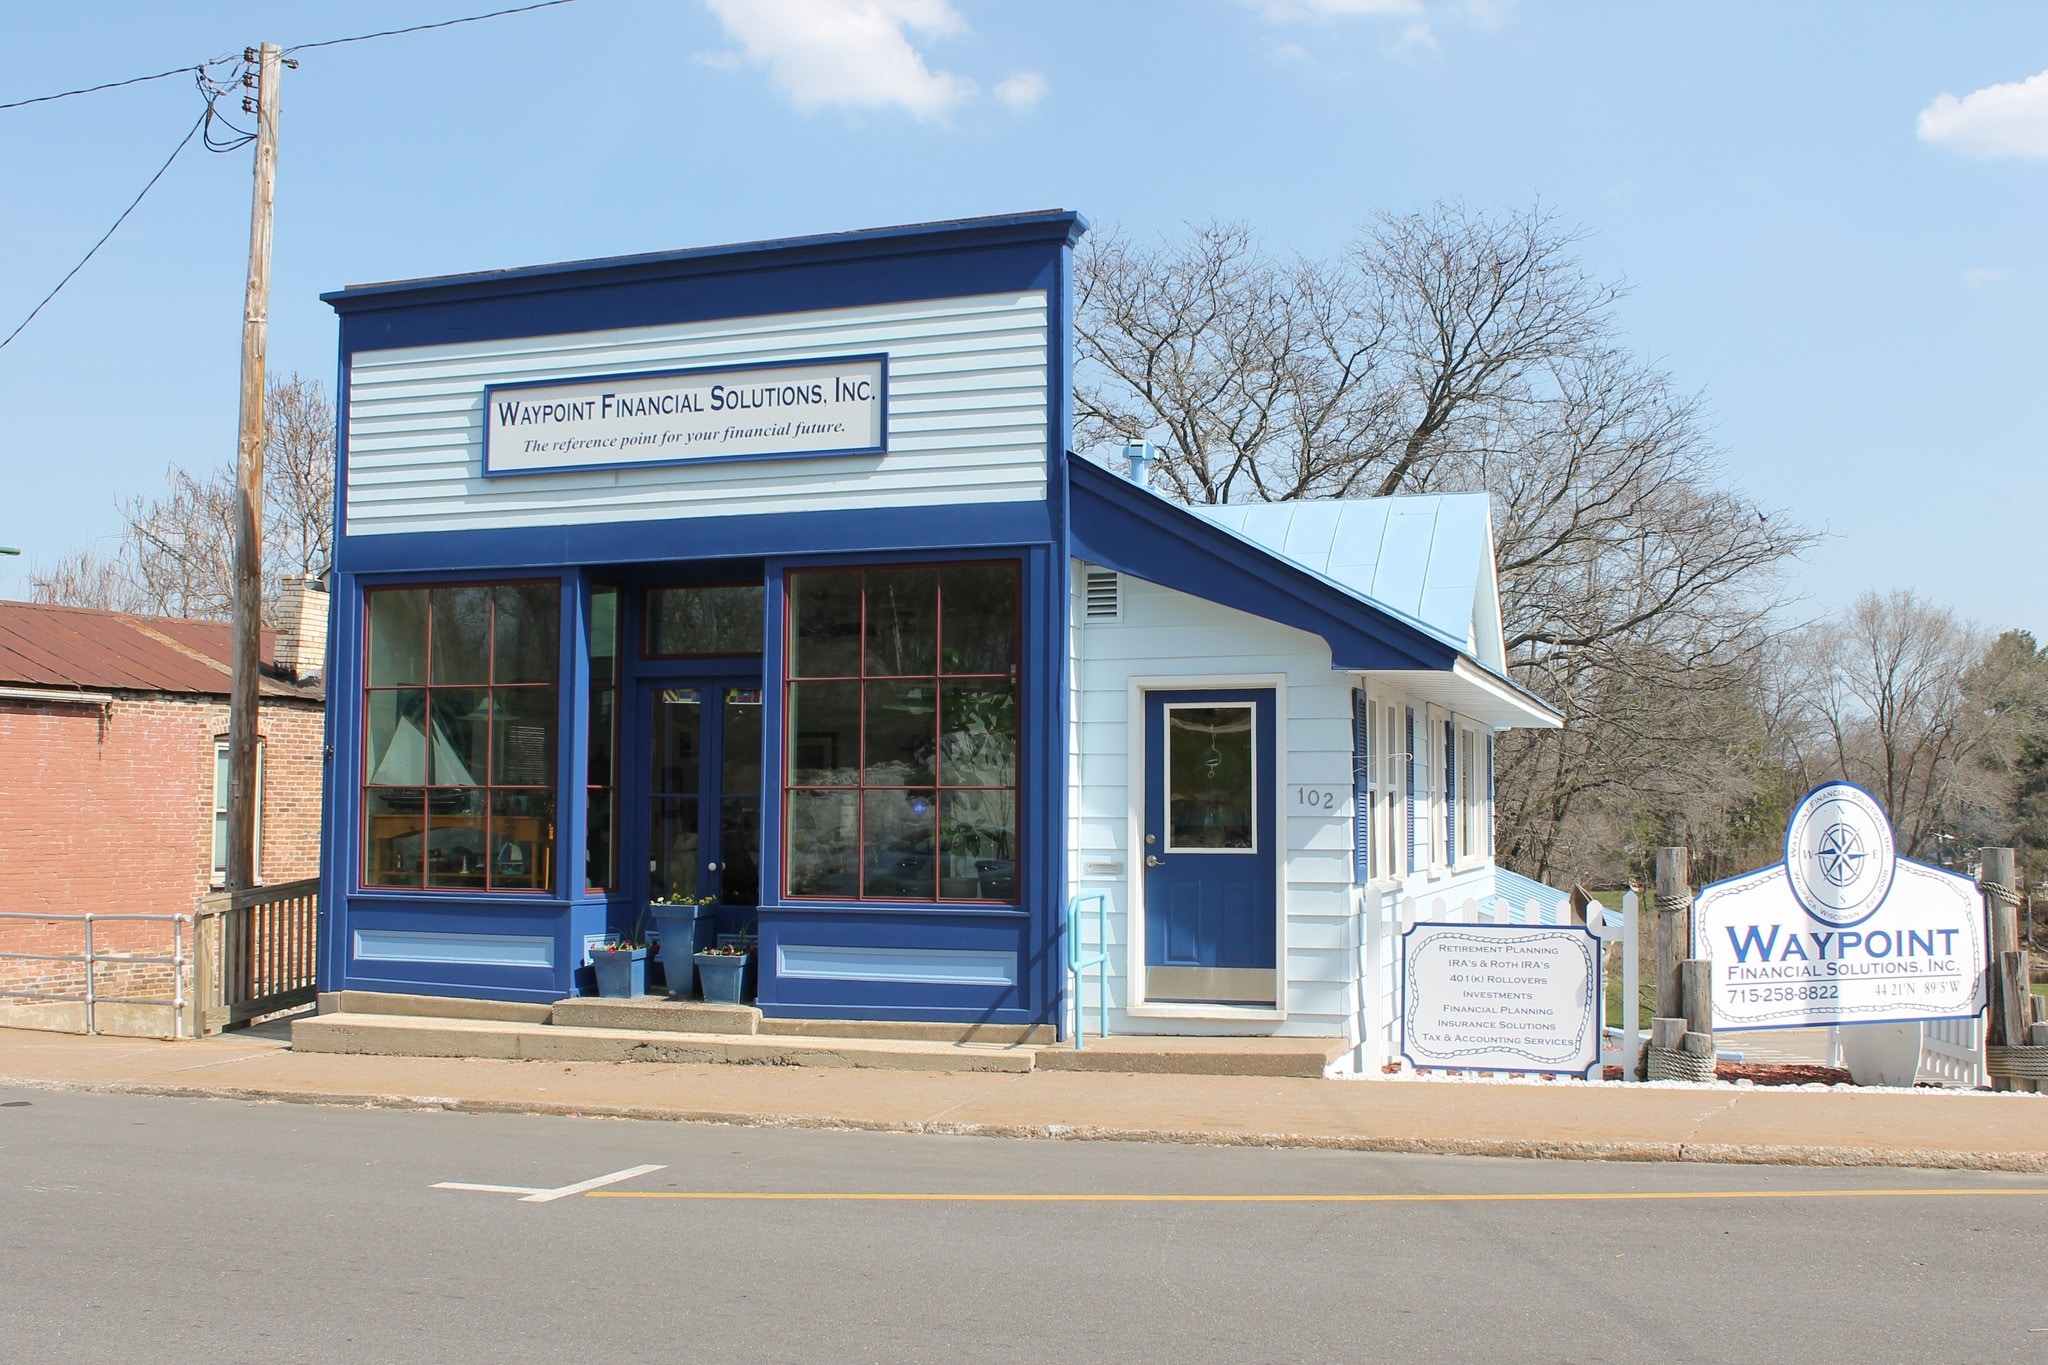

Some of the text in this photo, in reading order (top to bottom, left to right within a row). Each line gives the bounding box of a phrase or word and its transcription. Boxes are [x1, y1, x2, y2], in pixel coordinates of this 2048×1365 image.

[498, 376, 876, 426] WAYPOINT FINANCIAL SOLUTIONS, INC.
[523, 419, 845, 454] The reference point for your financial future.
[1298, 786, 1333, 809] 102
[1836, 805, 1845, 815] N
[1791, 809, 1811, 858] WAYPOINT
[1809, 789, 1853, 808] FINANCIAL
[1803, 849, 1814, 860] W
[1872, 849, 1880, 860] E
[1820, 907, 1860, 921] WISCONSIN
[1877, 869, 1889, 893] 2008
[1839, 895, 1846, 905] S
[1439, 944, 1559, 955] RETIREMENT PLANNING
[1724, 924, 1959, 964] WAYPOINT
[1480, 960, 1488, 968] &
[1490, 960, 1519, 969] ROTH
[1728, 958, 1959, 980] FINANCIAL SOLUTIONS, INC.
[1487, 975, 1548, 985] ROLLOVERS
[1462, 990, 1533, 1000] INVESTMENTS
[1727, 985, 1839, 1004] 715-258-8822
[1443, 1004, 1554, 1016] FINANCIAL PLANNING
[1437, 1019, 1556, 1031] INSURANCE SOLUTIONS
[1422, 1033, 1574, 1046] TAX & ACCOUNTING SERVICES
